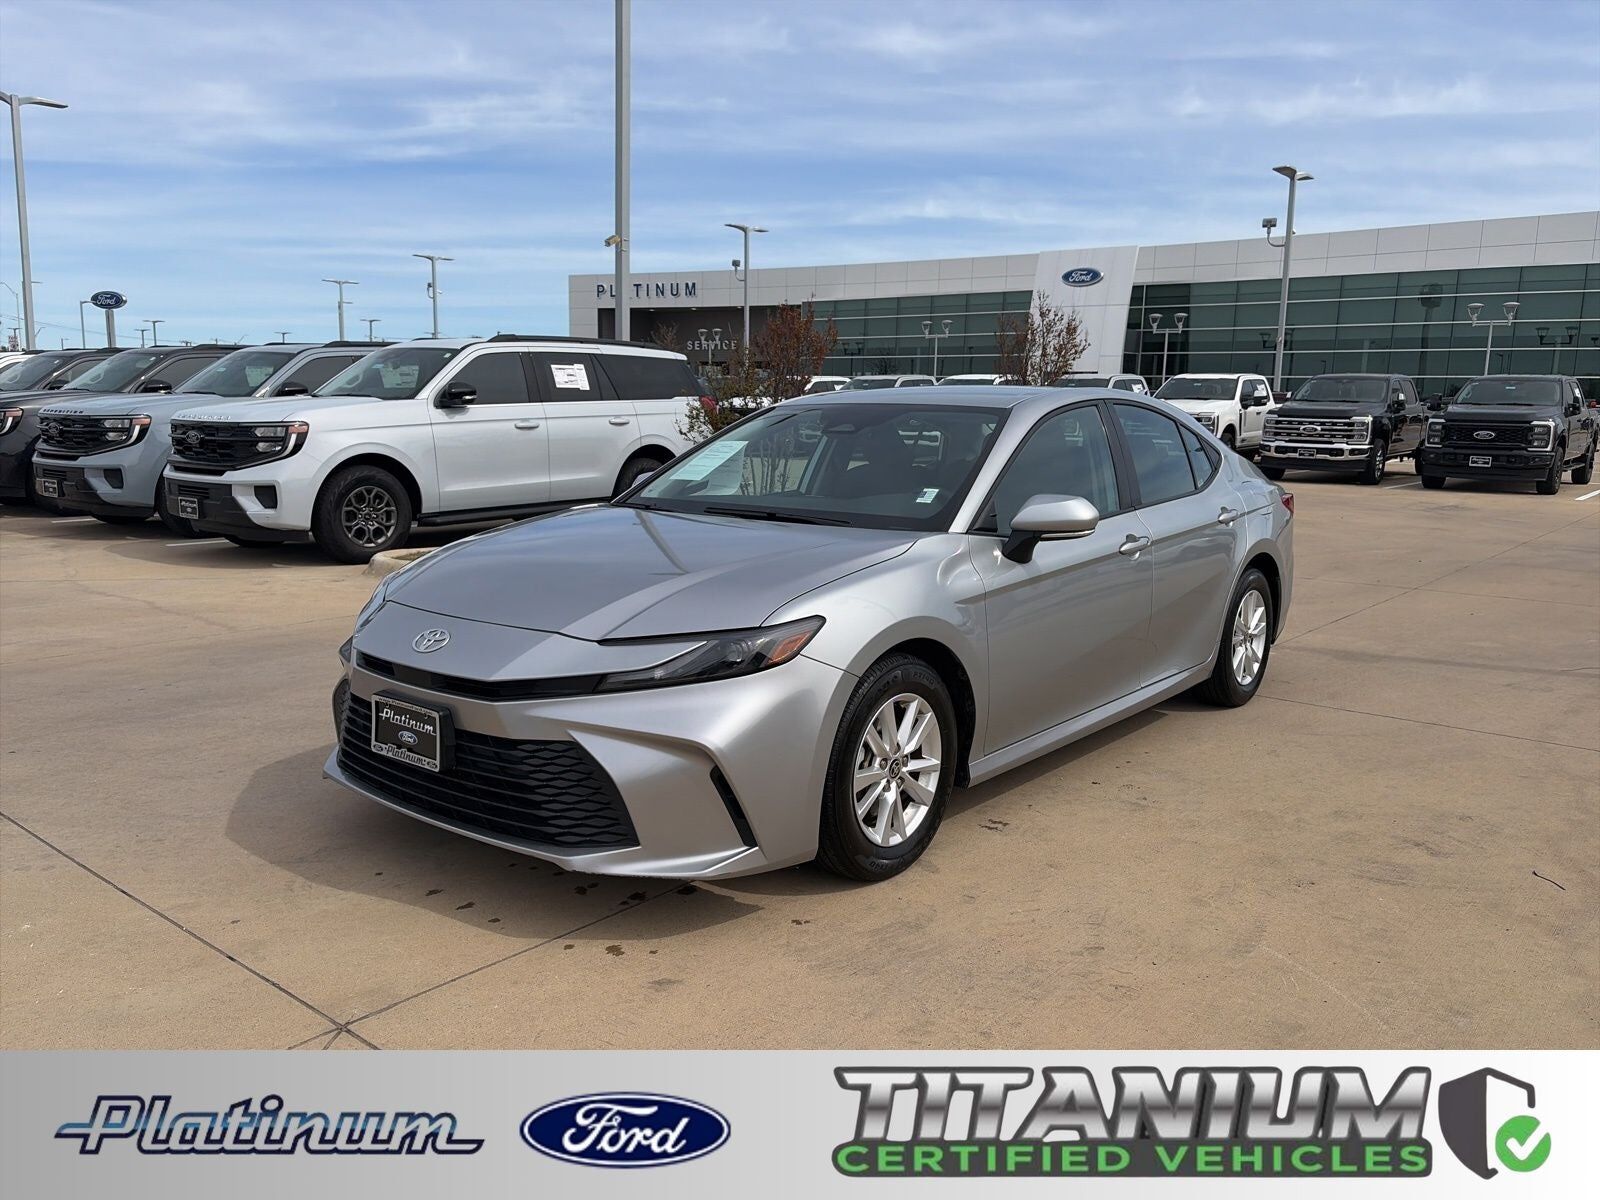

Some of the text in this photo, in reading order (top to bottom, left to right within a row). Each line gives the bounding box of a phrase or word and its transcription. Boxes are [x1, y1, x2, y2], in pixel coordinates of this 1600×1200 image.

[1069, 270, 1093, 281] Ford
[597, 281, 697, 298] PLTINUM
[96, 294, 116, 305] Ford
[687, 340, 737, 350] SERVICE
[379, 708, 436, 736] Platinum
[387, 744, 426, 766] Platinum
